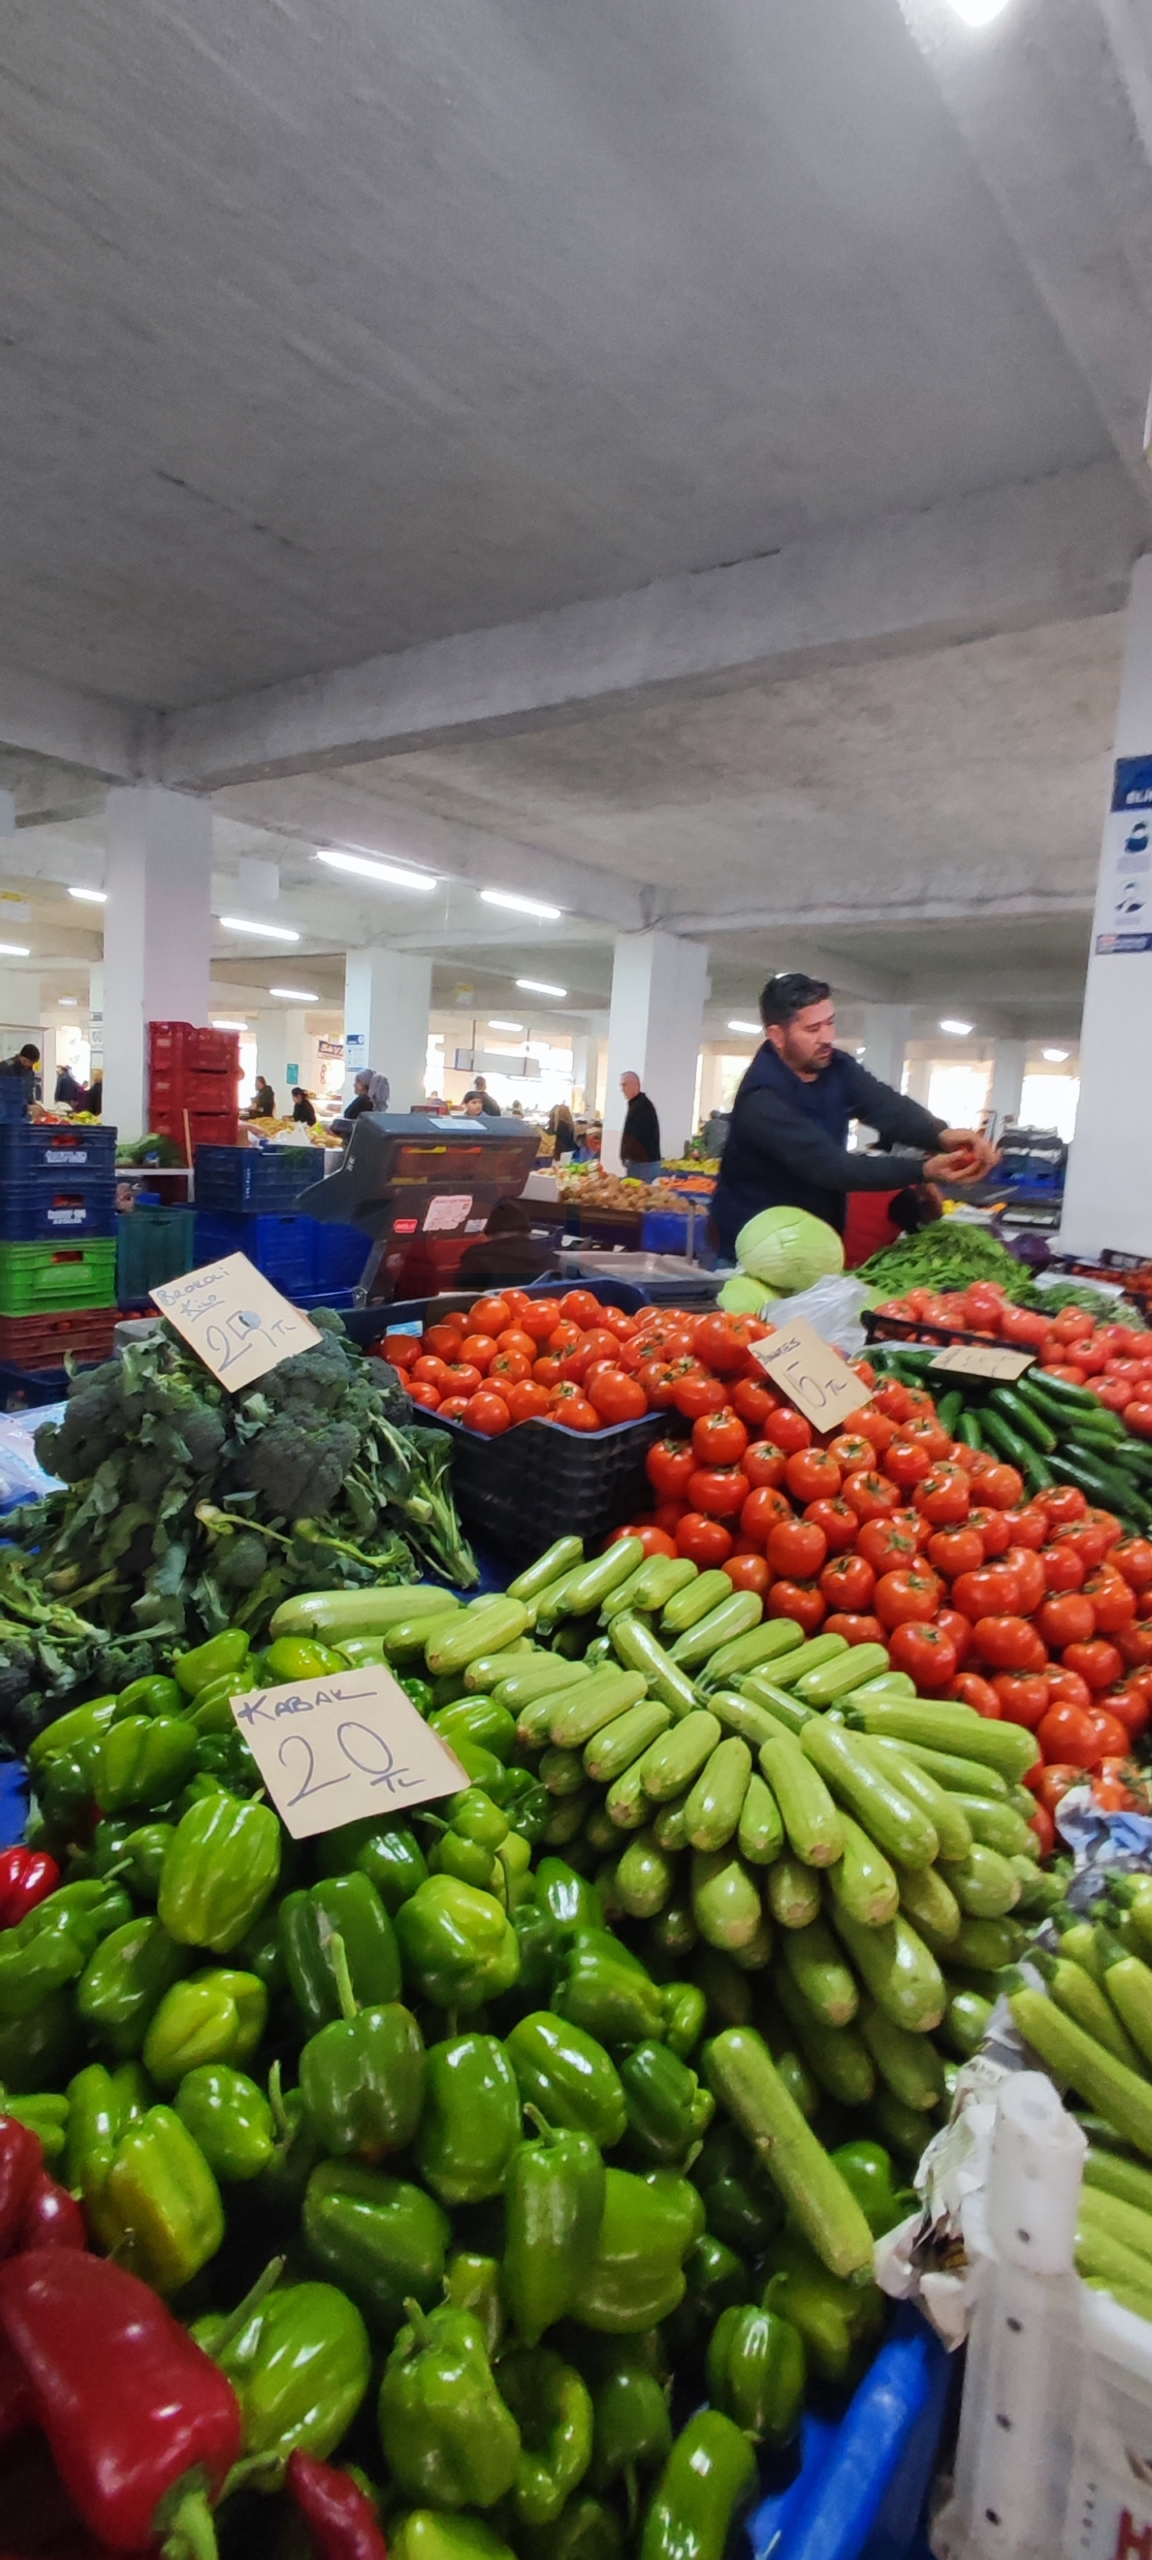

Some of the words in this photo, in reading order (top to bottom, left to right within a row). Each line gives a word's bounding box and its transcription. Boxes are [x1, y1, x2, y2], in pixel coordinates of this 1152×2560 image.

[237, 1689, 377, 1725] KABAK
[278, 1721, 394, 1807] 20
[369, 1767, 426, 1793] TL
